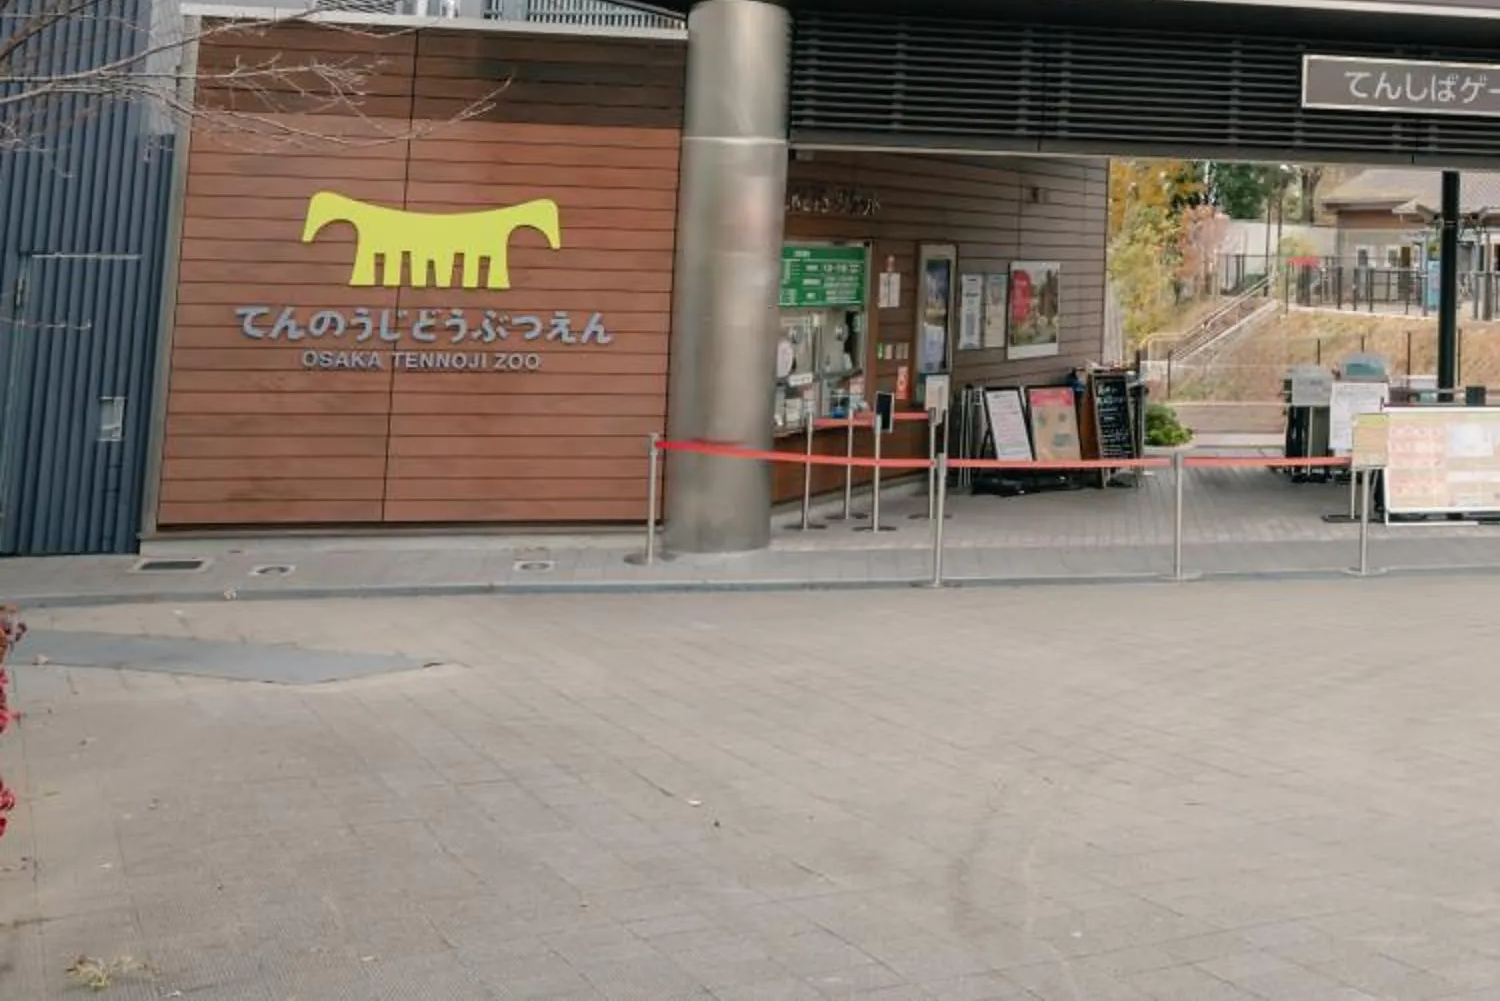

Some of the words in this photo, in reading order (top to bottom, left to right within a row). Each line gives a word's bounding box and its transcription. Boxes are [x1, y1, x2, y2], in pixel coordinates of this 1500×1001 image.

[233, 306, 613, 345] てんのうじどうぶつえん
[302, 349, 383, 369] OSAKA
[393, 350, 487, 370] TENNOJI
[495, 351, 542, 370] ZOO
